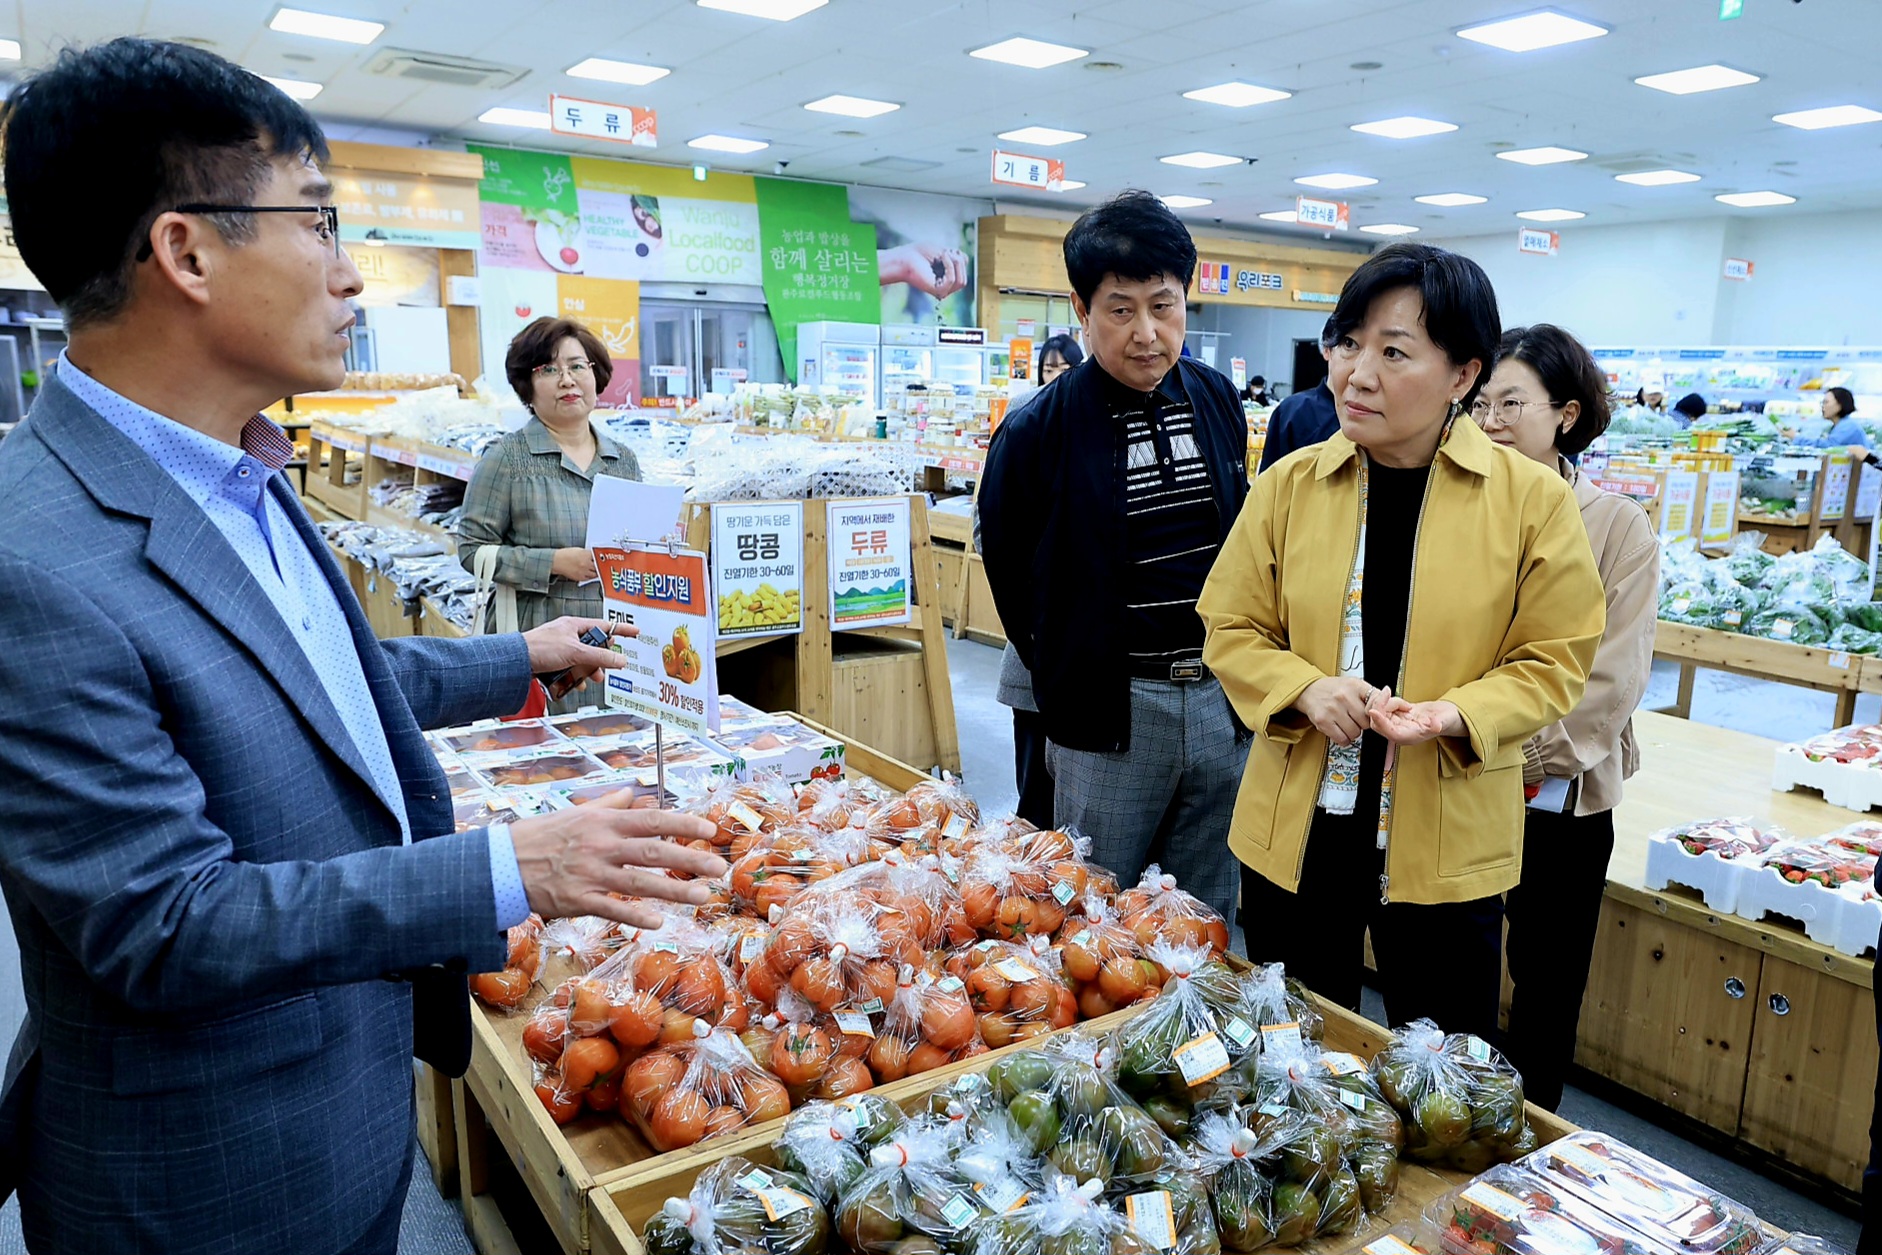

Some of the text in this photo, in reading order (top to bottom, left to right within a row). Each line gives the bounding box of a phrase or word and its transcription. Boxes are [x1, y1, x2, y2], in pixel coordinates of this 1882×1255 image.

[583, 212, 626, 226] HEALTHY
[682, 206, 740, 228] Wanju
[1301, 204, 1334, 223] 가공식품
[485, 223, 508, 238] 가격
[585, 225, 639, 240] VEGETABLE
[782, 229, 815, 244] 농업과
[668, 228, 756, 254] Localfood
[686, 253, 743, 275] COOP
[769, 246, 870, 274] 함께 살리는
[1236, 270, 1283, 291] 우리포크
[563, 296, 585, 312] 안심
[754, 514, 771, 527] 가득
[773, 513, 791, 527] 담은
[841, 512, 895, 526] 지역에서 재배한
[737, 532, 780, 561] 땅콩
[850, 529, 888, 556] 두류
[723, 564, 794, 580] 진열기한 30~60일
[839, 567, 901, 583] 진열기한 30~60일
[610, 565, 691, 602] 농식품부 할인지원
[658, 680, 680, 708] 30%
[680, 693, 704, 716] 할인적용
